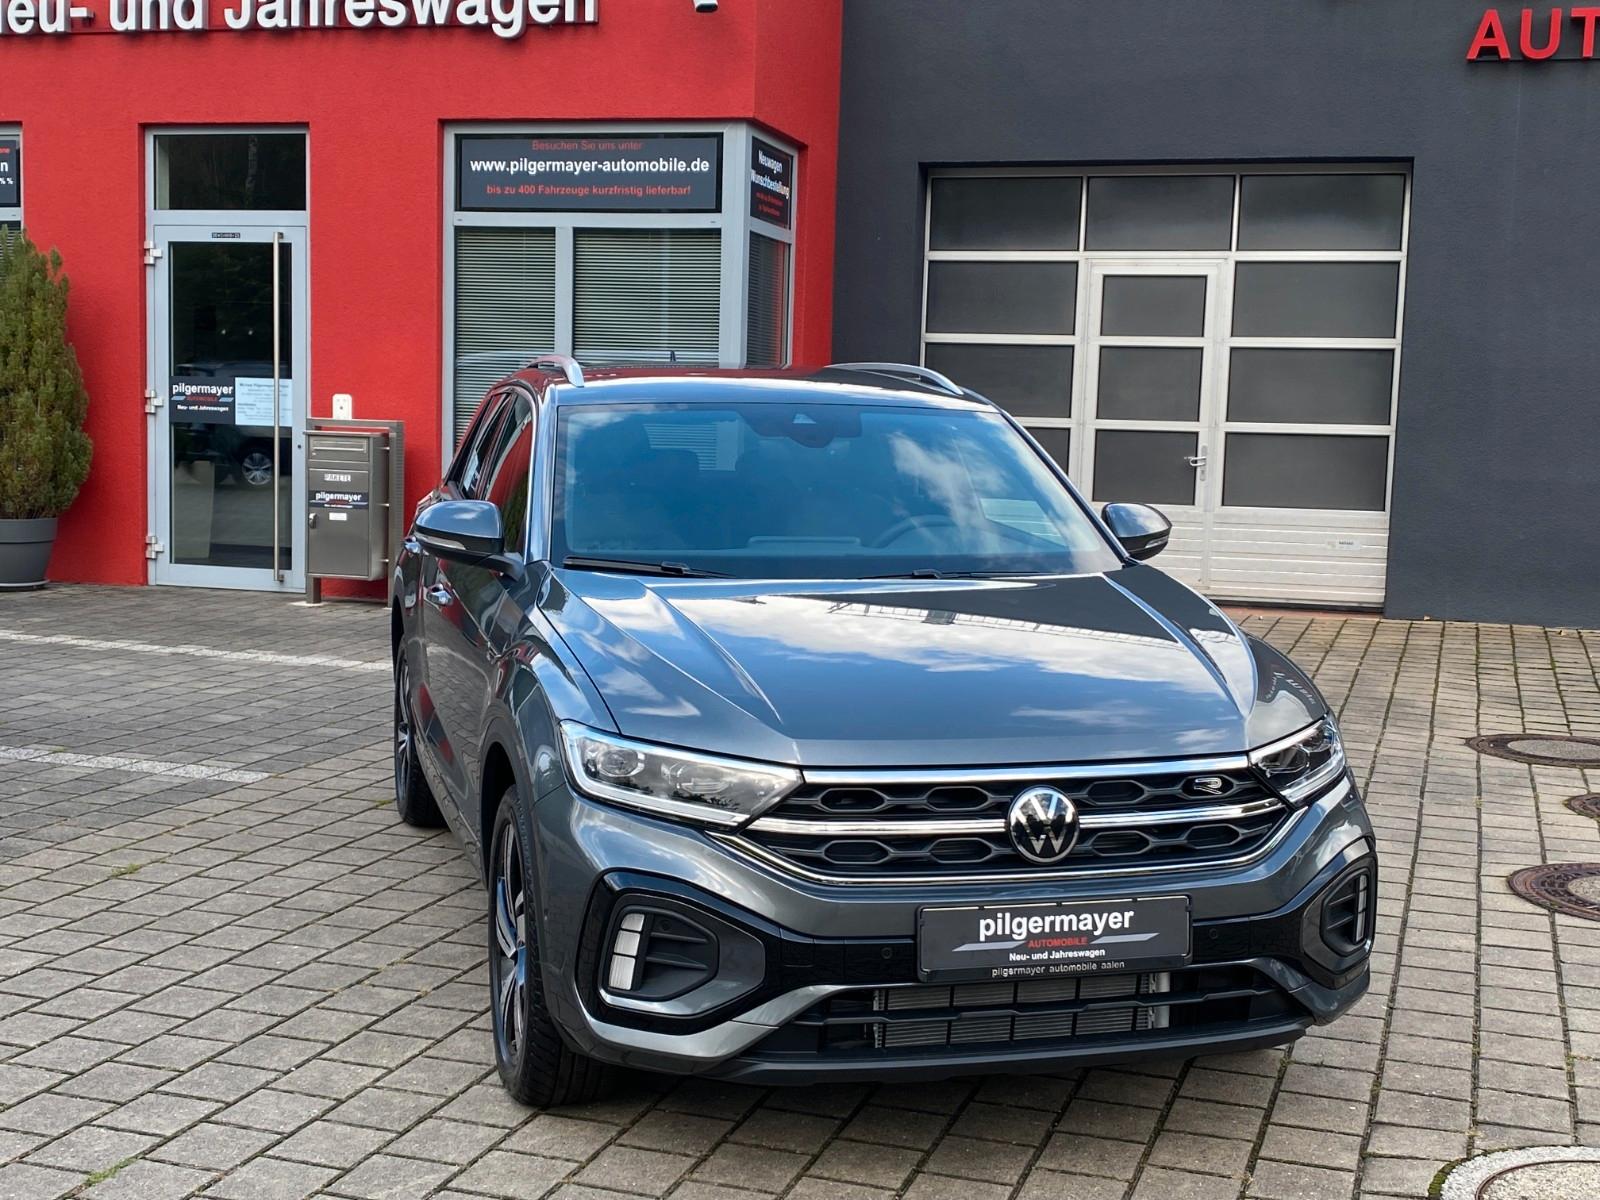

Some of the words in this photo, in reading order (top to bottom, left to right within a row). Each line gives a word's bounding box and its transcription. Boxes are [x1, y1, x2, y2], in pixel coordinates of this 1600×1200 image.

[0, 0, 90, 34] eu-
[531, 140, 578, 151] Besuchen
[618, 140, 643, 151] unter
[470, 157, 710, 176] www.pilgermayer-automobile.de
[486, 184, 502, 194] bis
[504, 186, 516, 194] zu
[518, 184, 536, 195] 400
[538, 184, 590, 197] Fahrzeuge
[592, 185, 643, 198] kurzfristig
[645, 185, 691, 196] lieferbar!
[172, 382, 234, 396] pilgermayer
[315, 491, 362, 503] pilgermayer
[979, 910, 1135, 942] pilgermayer
[1028, 937, 1089, 950] AUTOMOBILE
[1008, 951, 1030, 962] Neu-
[1031, 950, 1049, 961] und
[1049, 948, 1106, 959] Jahreswagen
[991, 965, 1046, 978] pilgermayer
[1049, 961, 1098, 973] automobile
[1100, 960, 1126, 970] aalen
